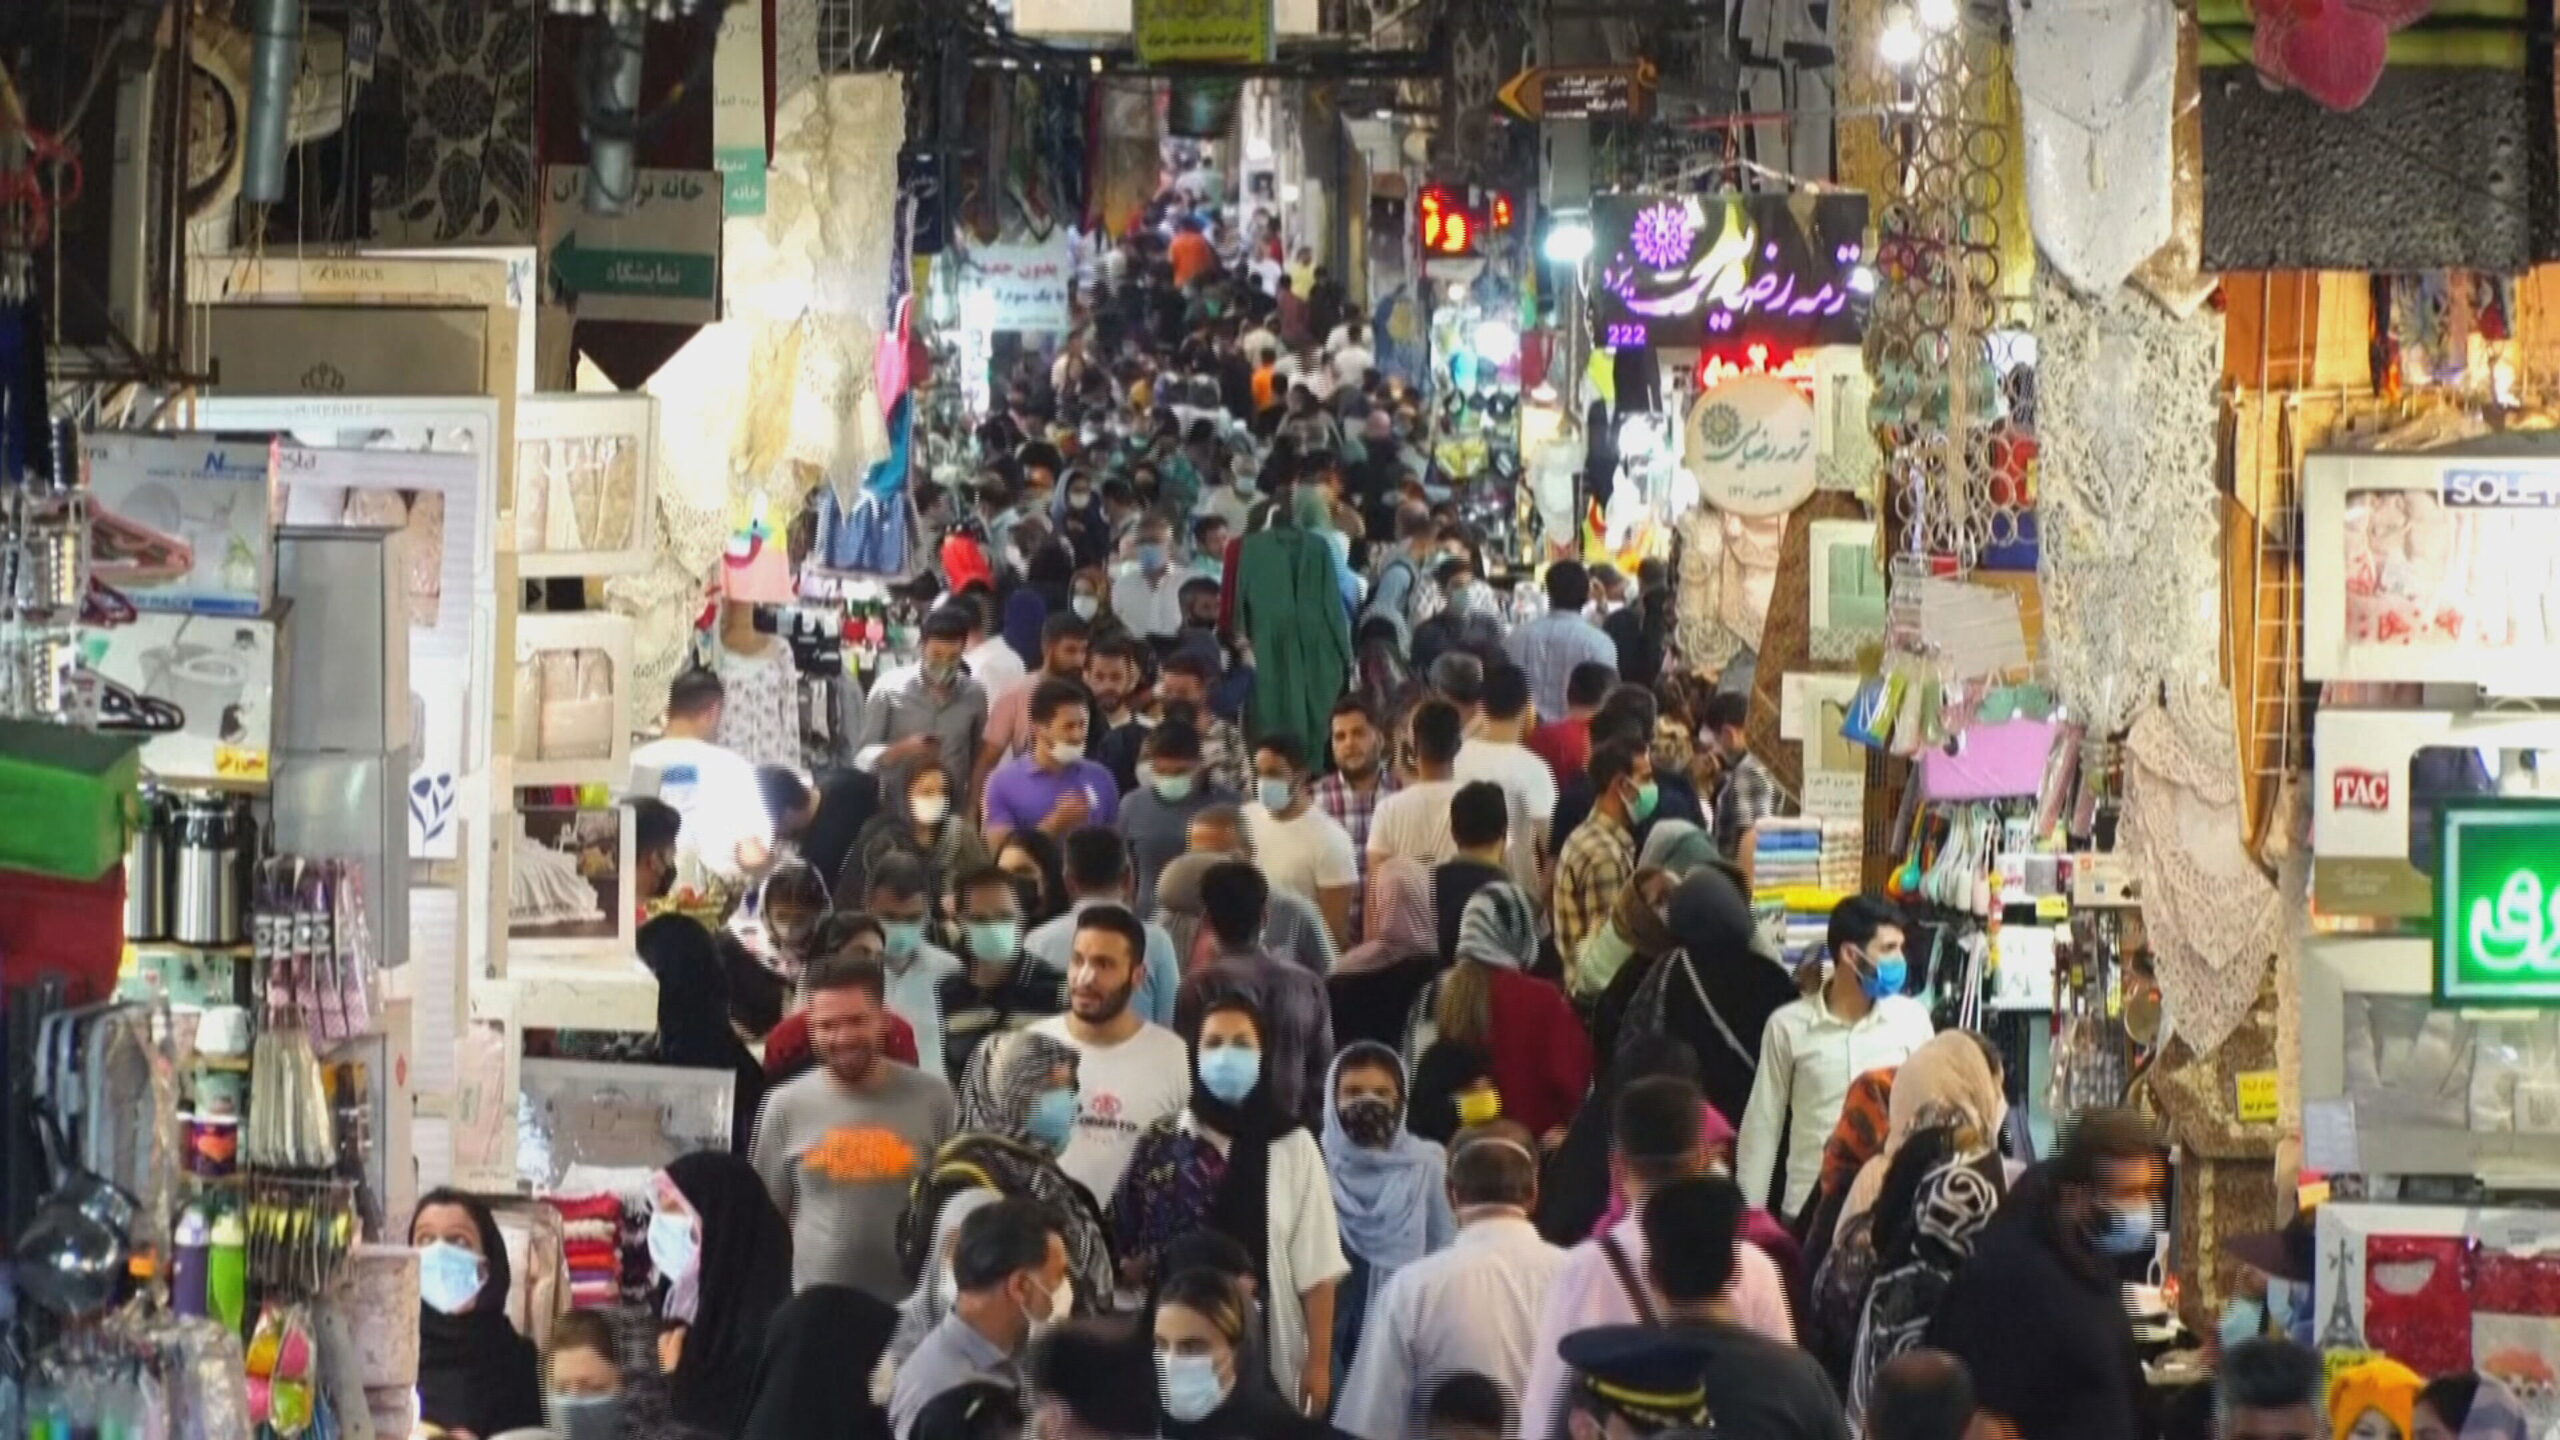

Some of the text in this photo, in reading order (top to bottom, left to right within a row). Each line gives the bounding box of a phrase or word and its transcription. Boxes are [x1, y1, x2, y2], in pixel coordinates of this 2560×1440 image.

[662, 173, 703, 199] خانه
[606, 259, 680, 284] نمایشگاه
[1788, 243, 1861, 317] ترمه
[1607, 324, 1646, 345] 222
[1774, 430, 1811, 463] ترمه
